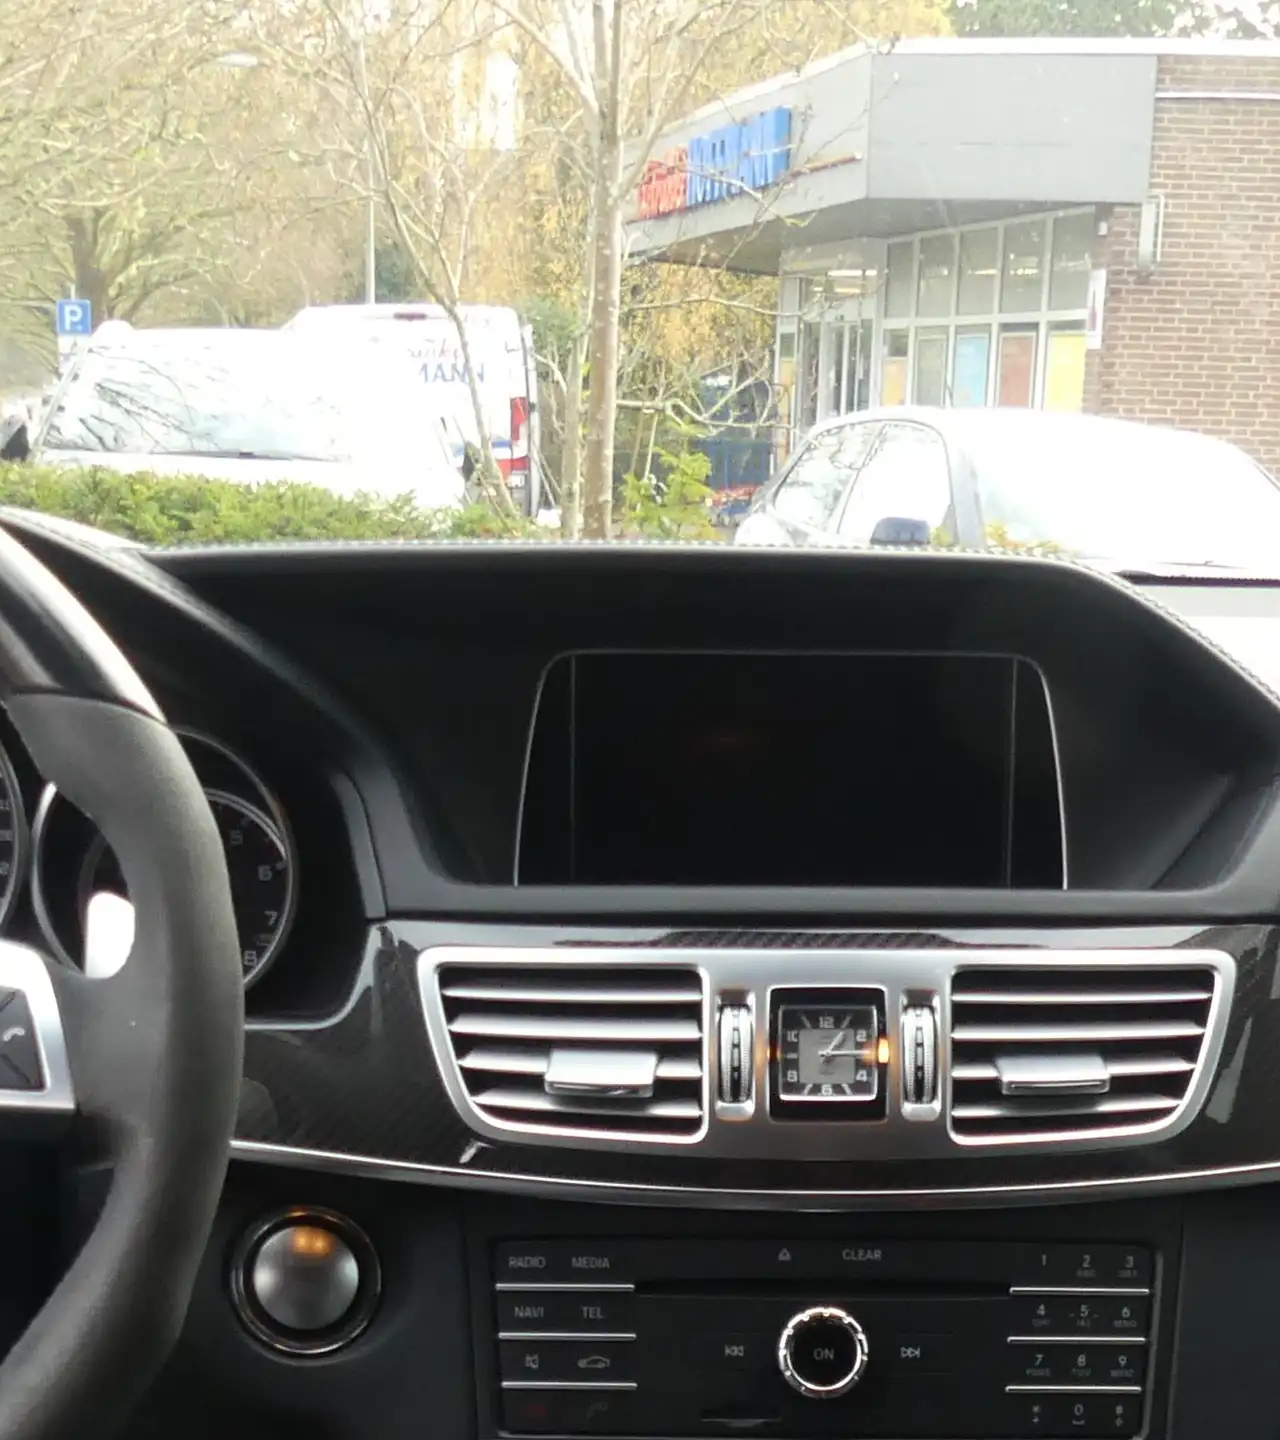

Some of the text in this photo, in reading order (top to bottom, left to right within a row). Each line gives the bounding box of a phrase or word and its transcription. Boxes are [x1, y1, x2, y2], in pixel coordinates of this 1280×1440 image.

[64, 305, 83, 331] P
[257, 865, 273, 881] 6
[263, 911, 278, 926] 7
[243, 949, 258, 966] 8
[818, 1016, 835, 1028] 12
[856, 1029, 867, 1042] 2
[786, 1070, 798, 1082] 8
[855, 1069, 868, 1082] 4
[821, 1084, 833, 1096] 6
[842, 1249, 882, 1260] CLEAR
[1040, 1254, 1047, 1266] 1
[508, 1256, 546, 1269] RADIO
[571, 1256, 610, 1269] MEDIA
[1082, 1255, 1091, 1268] 2
[1125, 1256, 1134, 1268] 3
[514, 1305, 544, 1318] NAVI
[581, 1305, 604, 1318] TEL
[1036, 1304, 1046, 1316] 4
[1080, 1305, 1089, 1317] 5
[1121, 1306, 1131, 1318] 6
[813, 1347, 834, 1360] ON
[1035, 1354, 1045, 1366] 7
[1077, 1354, 1087, 1367] 8
[1118, 1355, 1128, 1368] 9
[1074, 1403, 1083, 1416] 0
